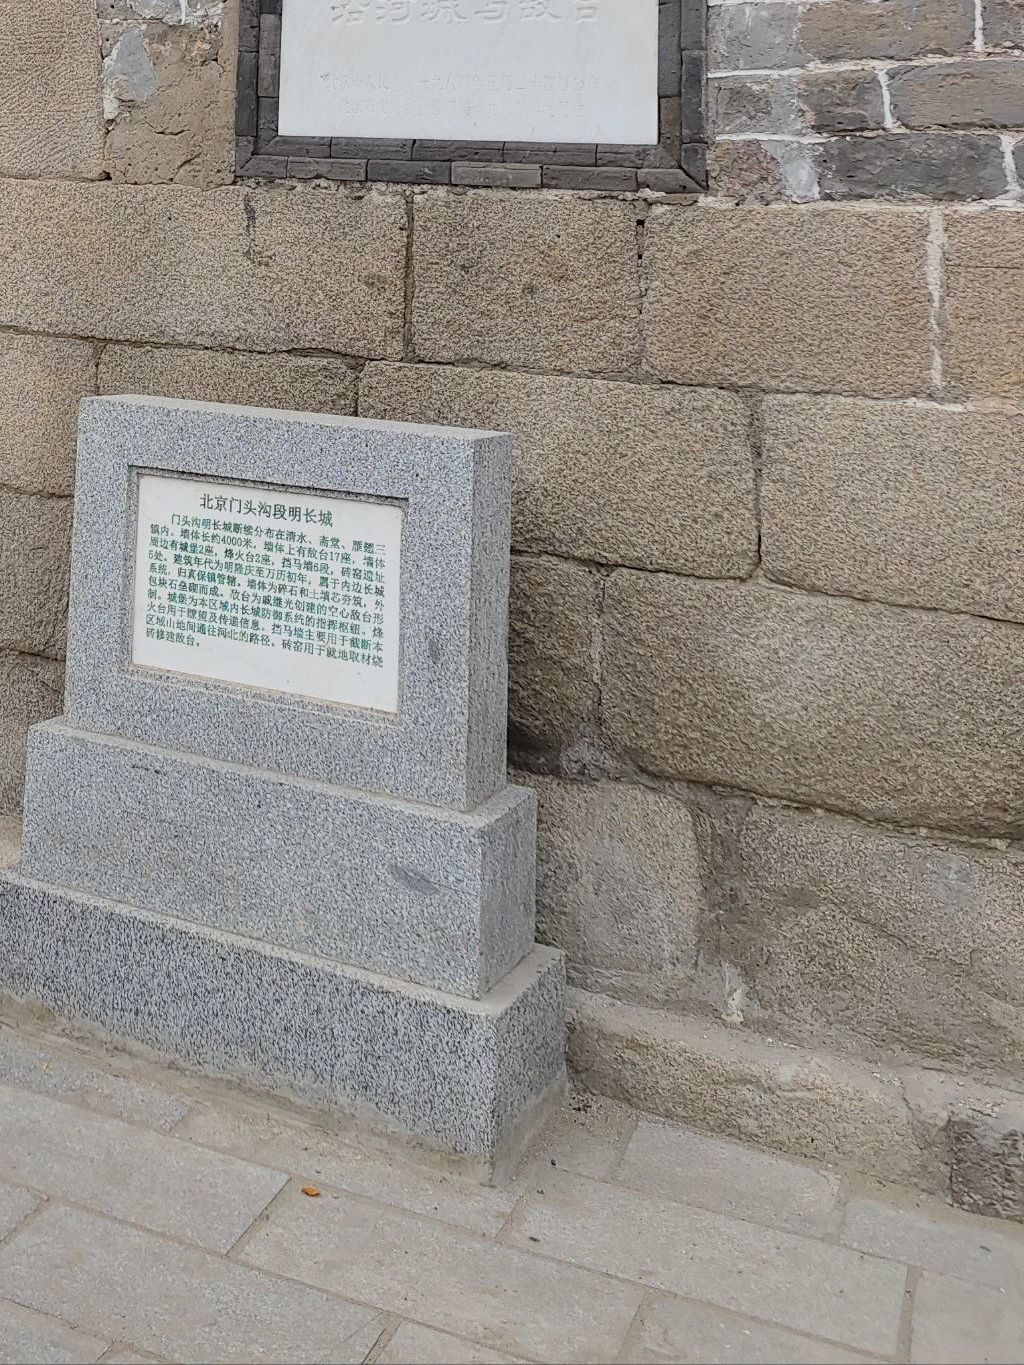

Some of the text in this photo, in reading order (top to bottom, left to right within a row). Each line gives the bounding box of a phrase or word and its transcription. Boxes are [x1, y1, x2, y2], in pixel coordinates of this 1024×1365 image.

[200, 493, 333, 527] 北京门头沟段明长城
[145, 627, 200, 647] 砖修建敌台。
